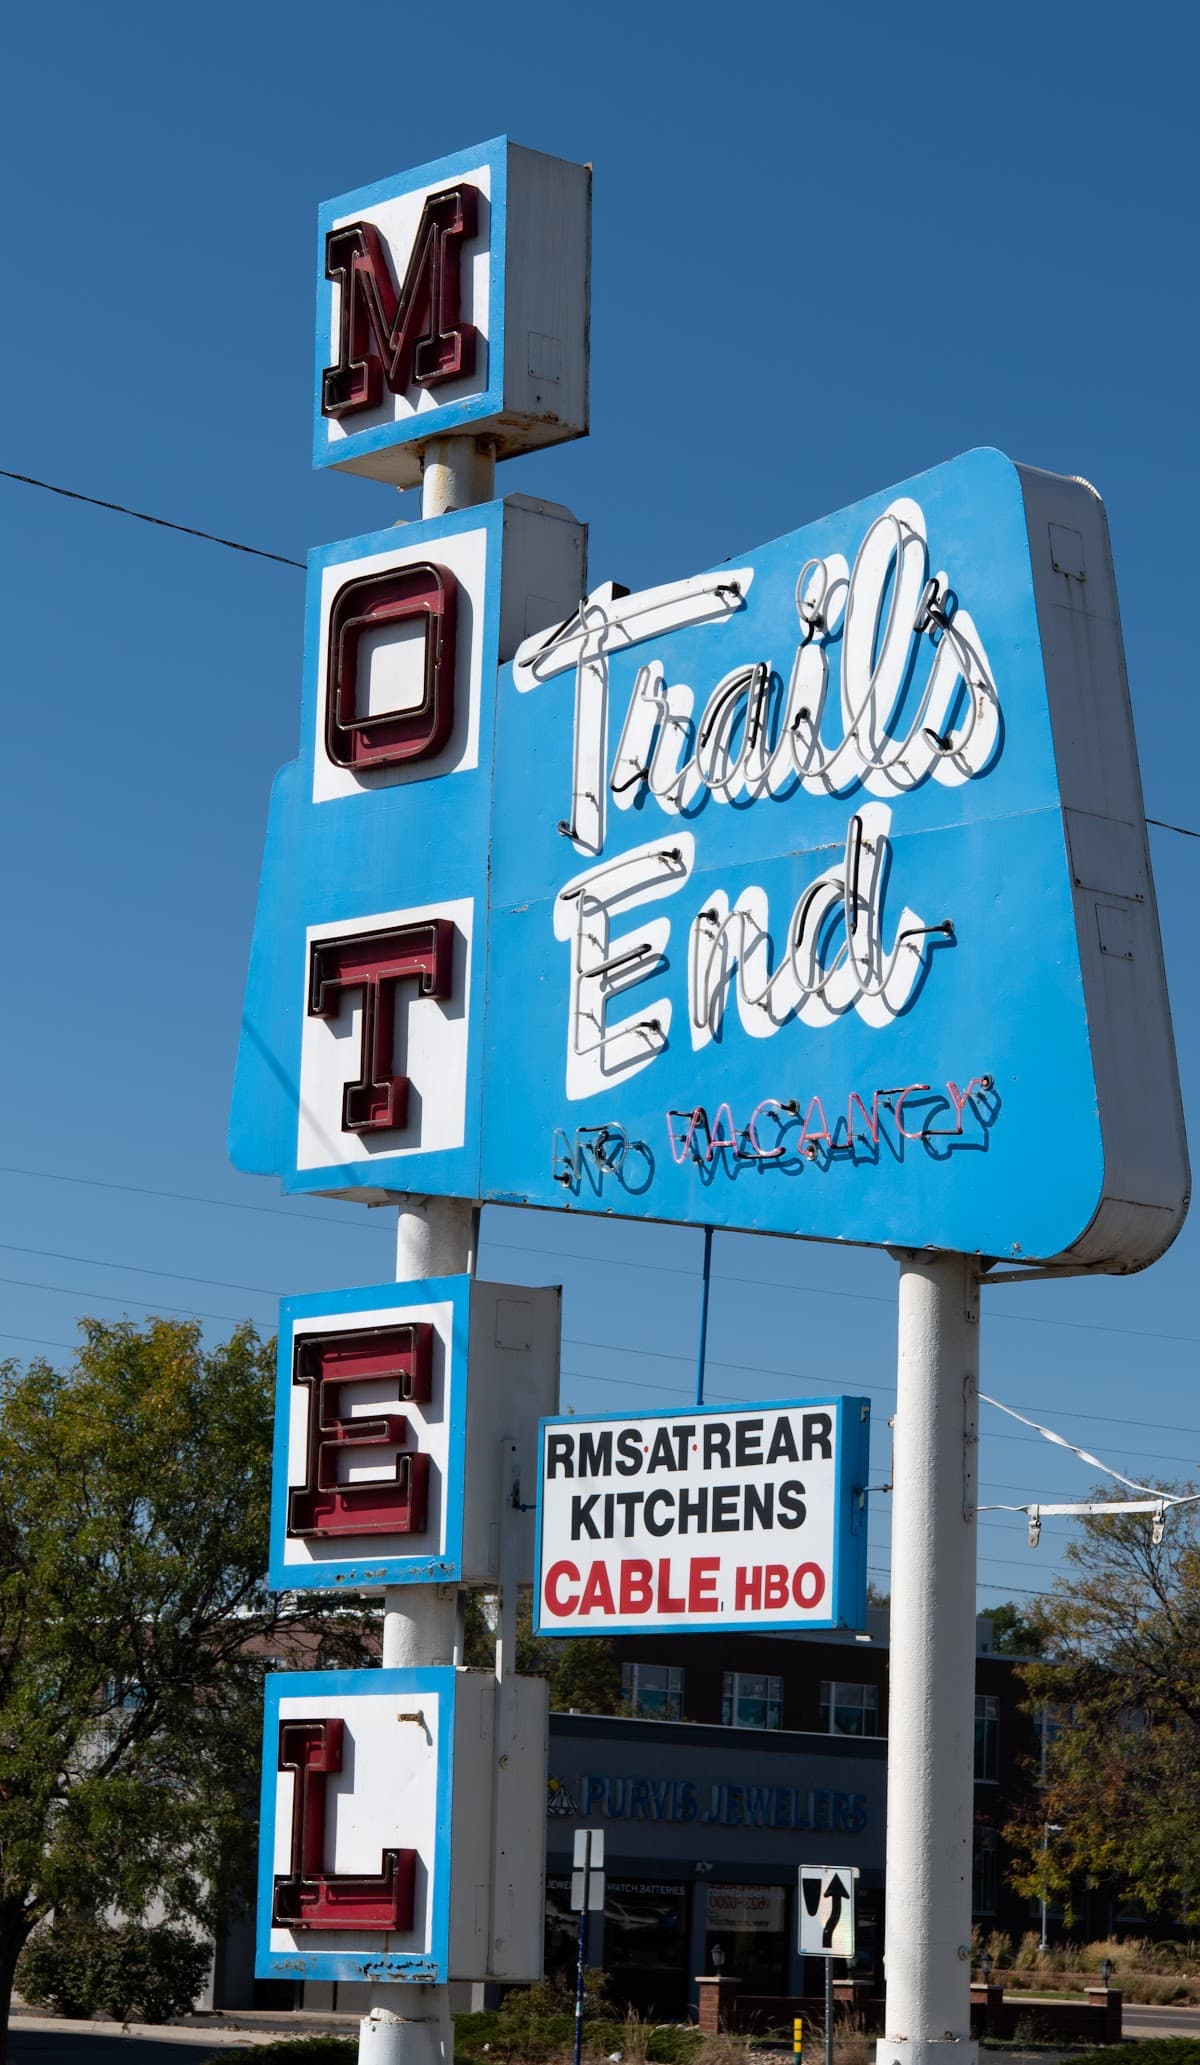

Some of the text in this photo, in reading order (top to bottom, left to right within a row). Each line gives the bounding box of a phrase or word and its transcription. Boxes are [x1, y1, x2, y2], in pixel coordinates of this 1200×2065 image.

[553, 801, 940, 1101] End
[552, 1076, 991, 1182] NO VACANCY
[703, 1413, 833, 1470] REAR
[571, 1480, 806, 1541] KITCHENS
[545, 1557, 826, 1617] CABLE HBO
[581, 1776, 868, 1832] PURVIS JEWELERS
[607, 1881, 639, 1894] WATCH
[640, 1884, 688, 1896] BATTERIES
